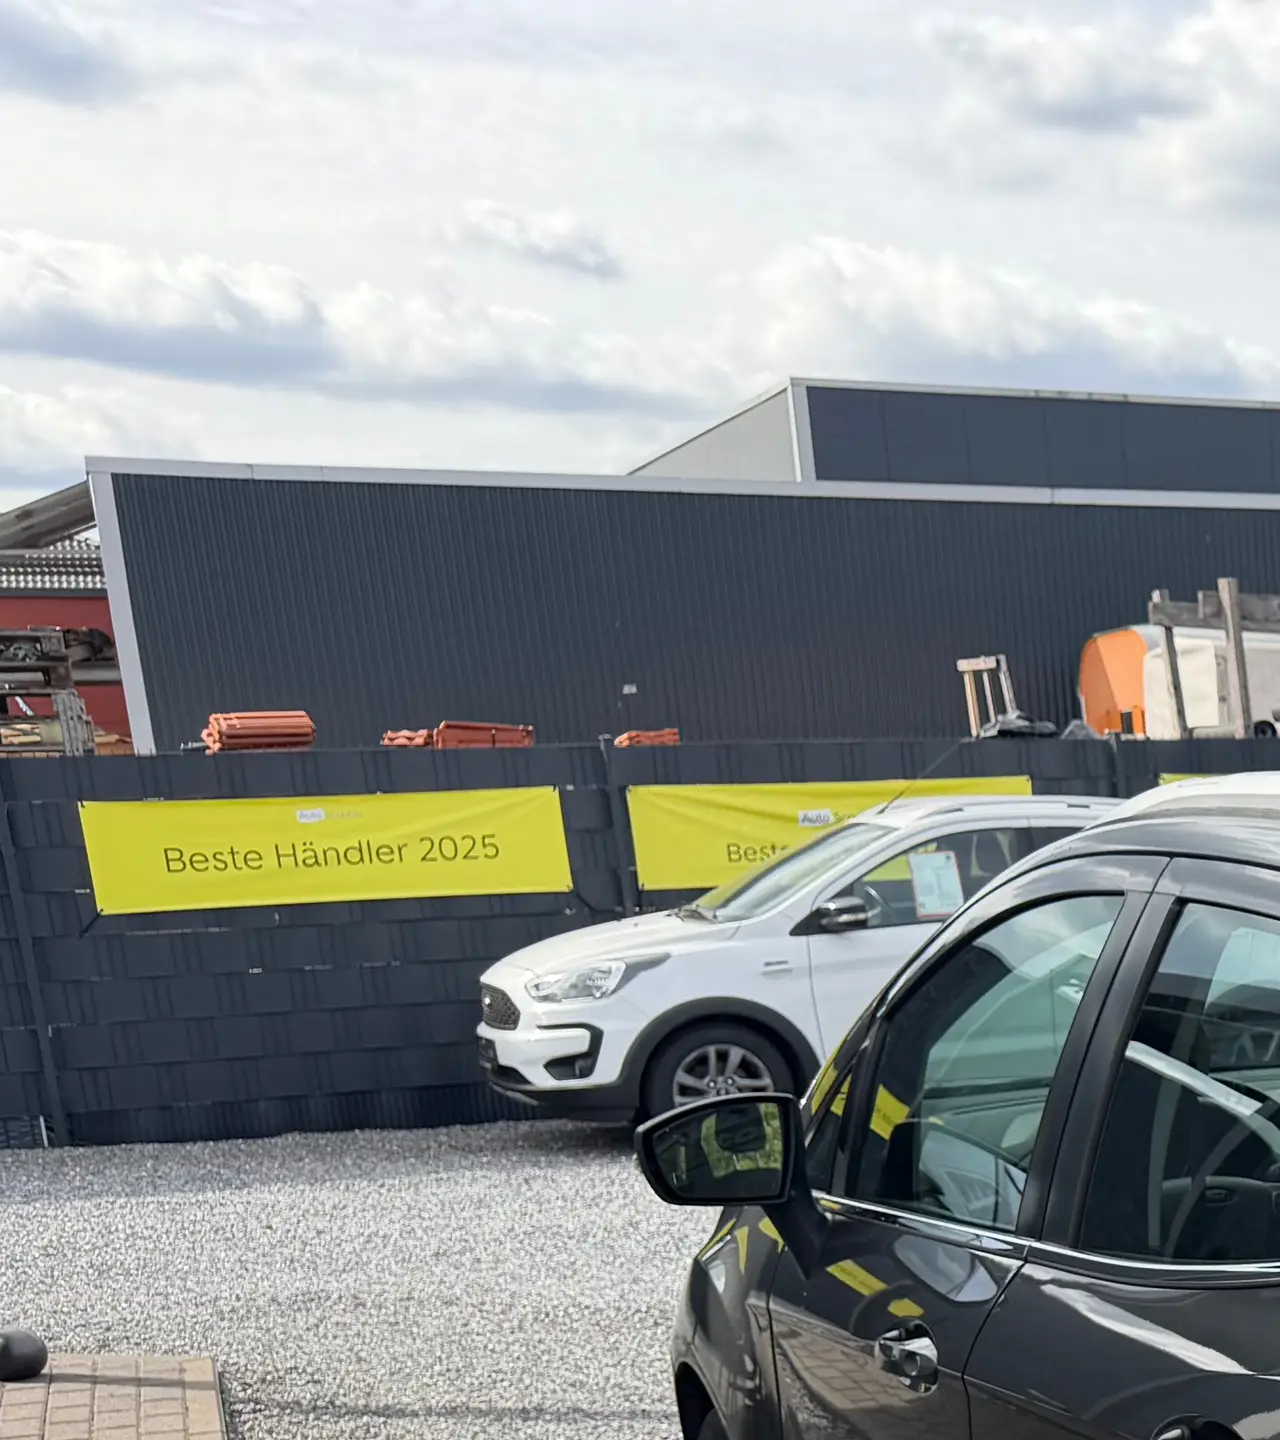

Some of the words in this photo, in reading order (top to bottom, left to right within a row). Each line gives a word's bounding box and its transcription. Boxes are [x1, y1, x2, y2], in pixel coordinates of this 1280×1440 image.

[164, 845, 263, 873] Beste
[275, 839, 408, 869] Händler
[419, 833, 500, 863] 2025
